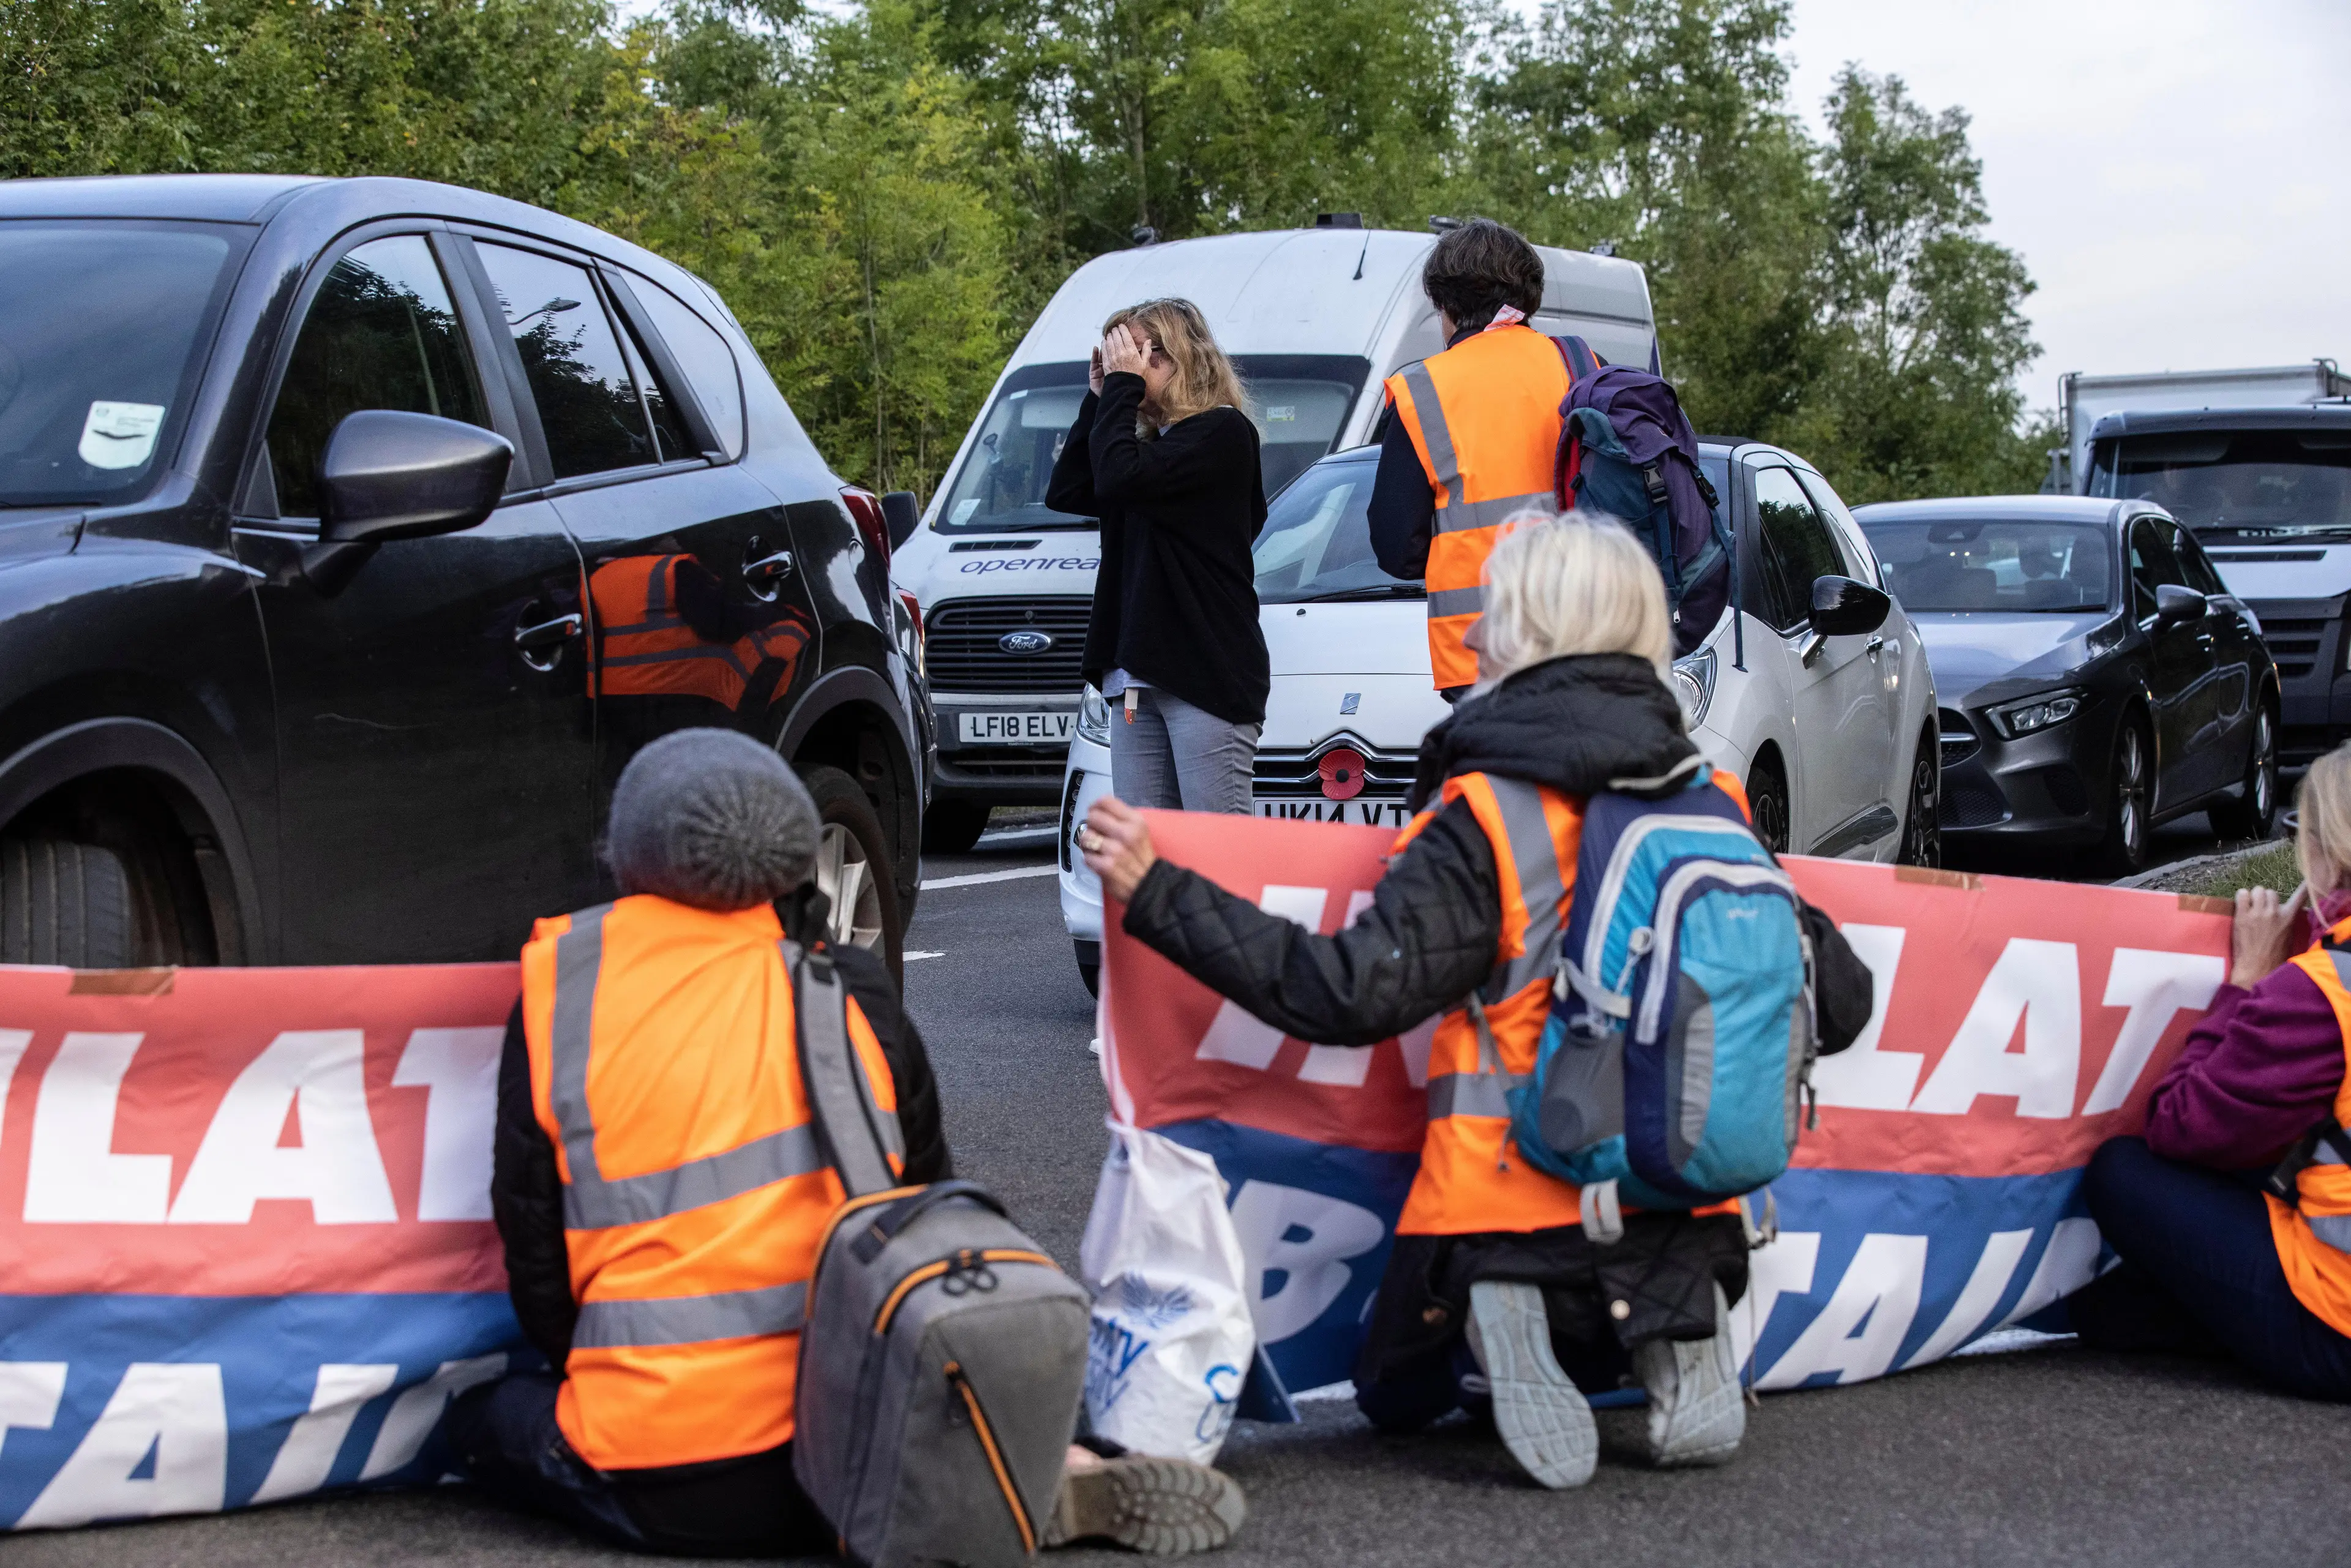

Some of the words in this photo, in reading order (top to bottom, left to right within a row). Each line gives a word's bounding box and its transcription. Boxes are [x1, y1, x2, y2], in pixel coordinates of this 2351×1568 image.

[960, 558, 1100, 574] openrea
[1009, 636, 1037, 649] Ford
[973, 716, 1019, 737] LF18
[1027, 716, 1068, 737] ELV
[0, 1026, 508, 1224] LAT
